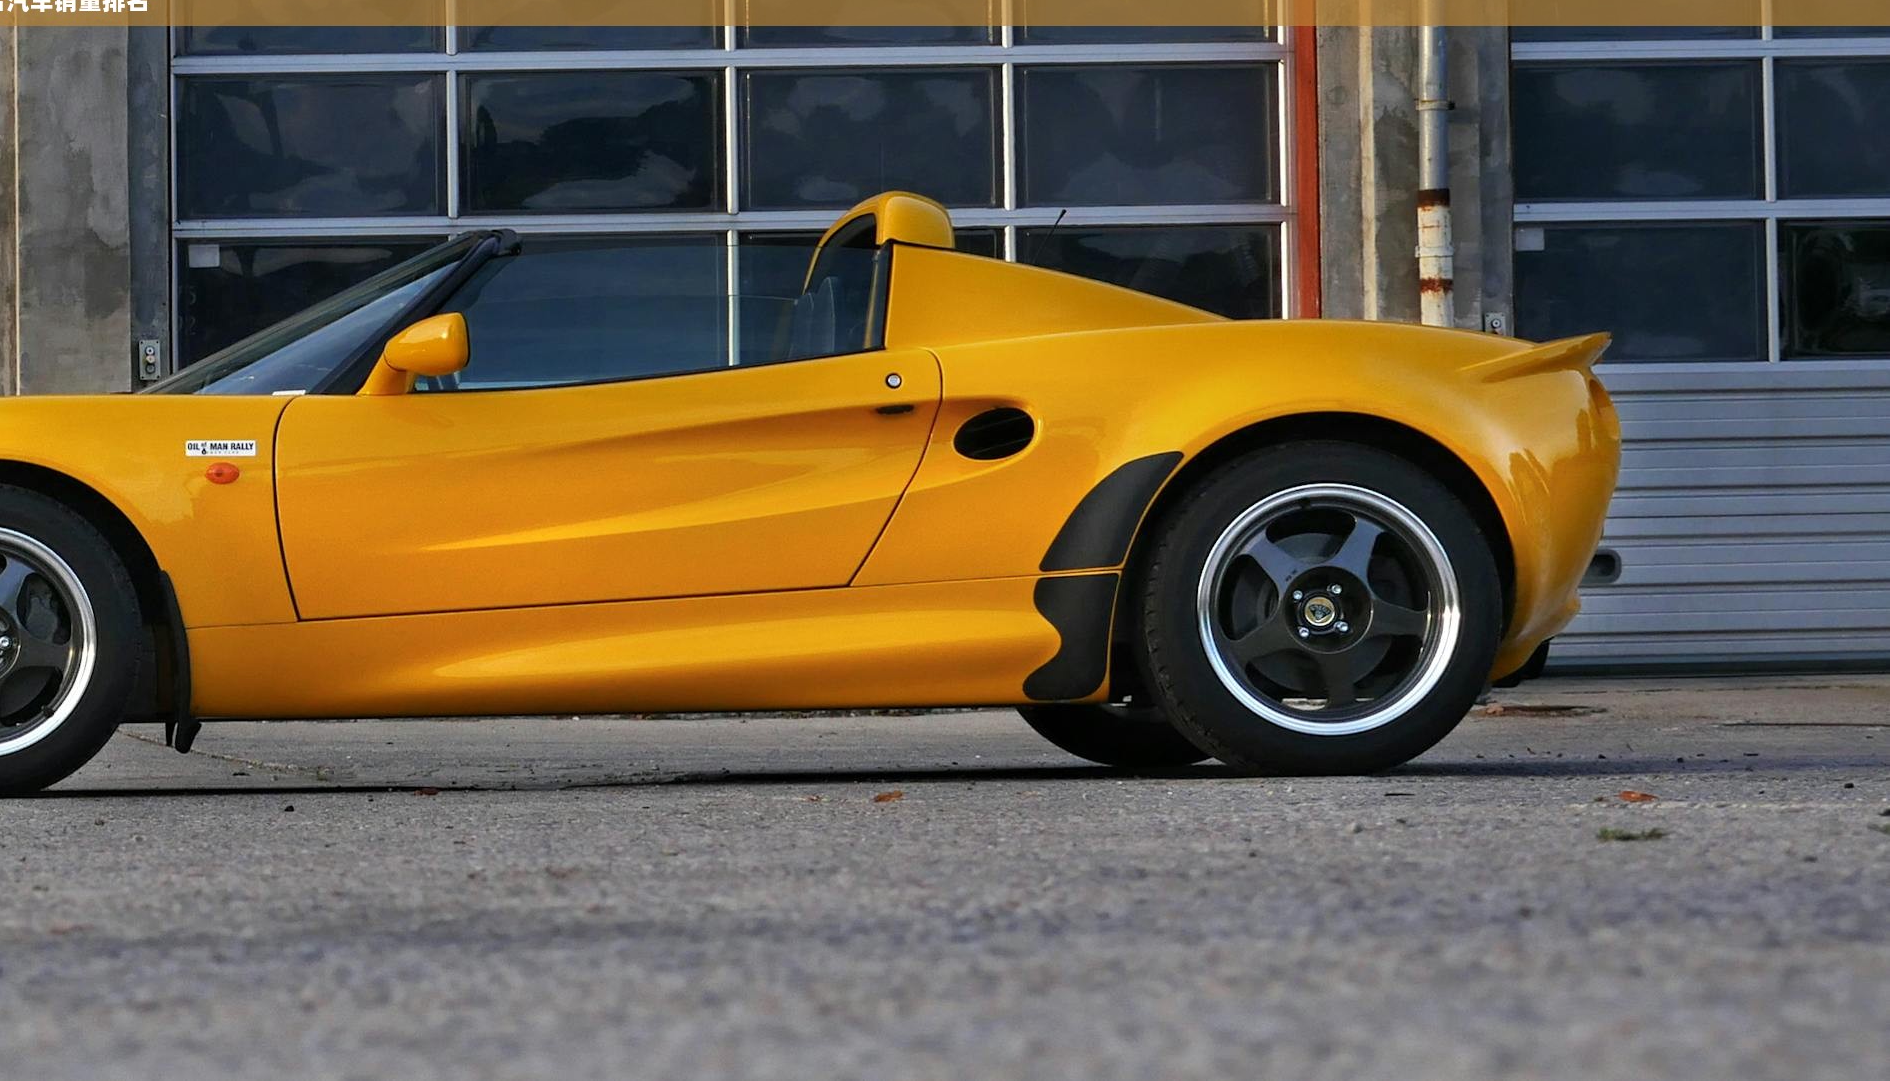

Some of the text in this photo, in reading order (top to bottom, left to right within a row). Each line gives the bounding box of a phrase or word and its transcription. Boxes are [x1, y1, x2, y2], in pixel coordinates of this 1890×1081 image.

[187, 442, 200, 450] OIL
[210, 442, 228, 450] MAN
[230, 442, 254, 450] RALLY
